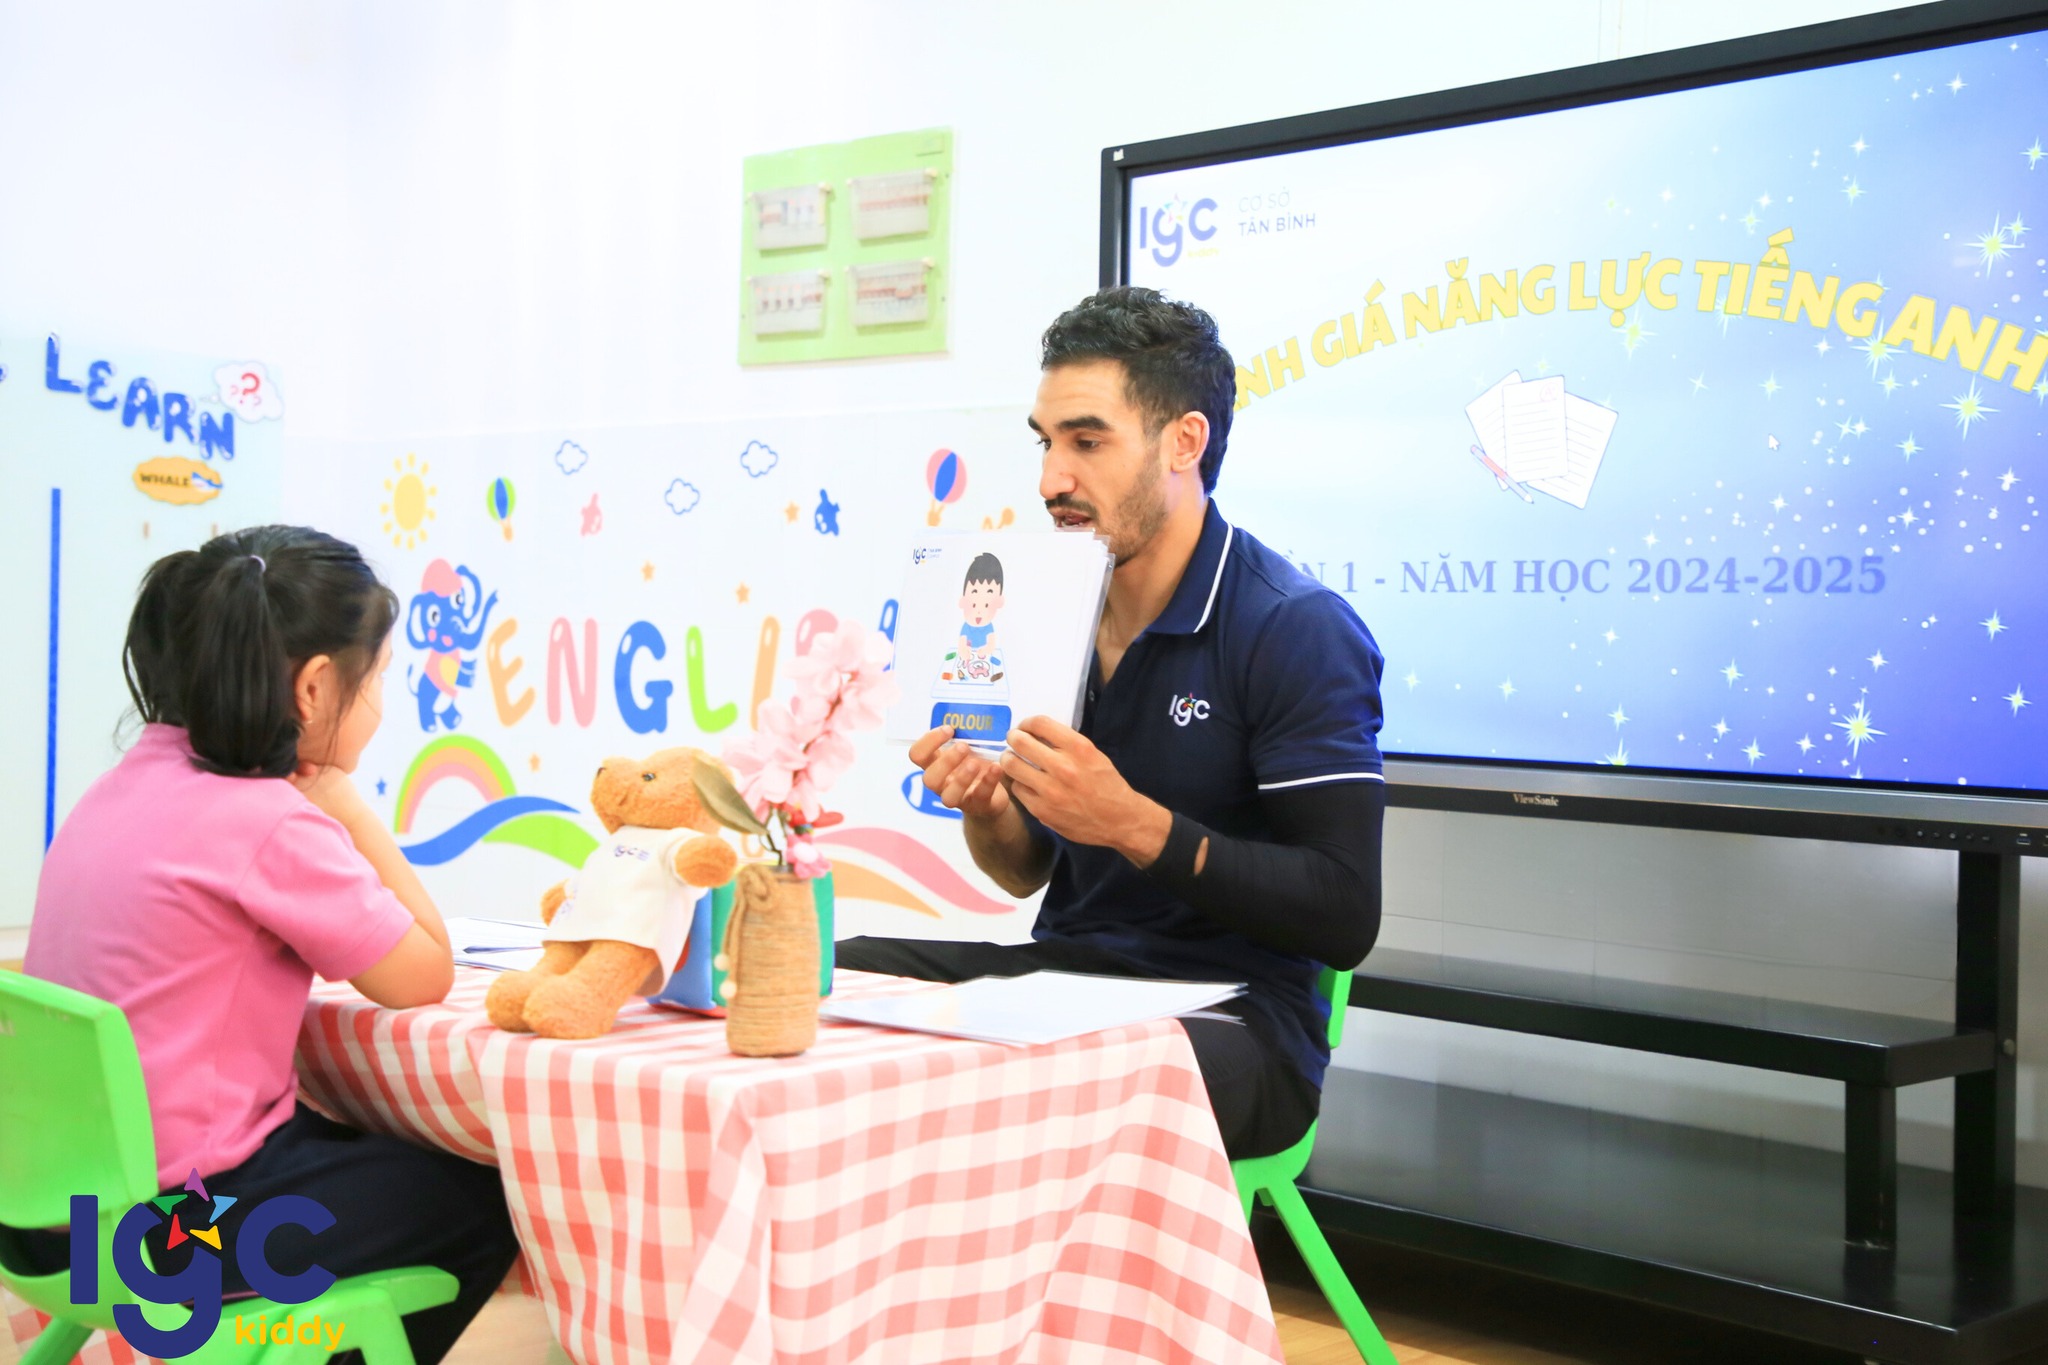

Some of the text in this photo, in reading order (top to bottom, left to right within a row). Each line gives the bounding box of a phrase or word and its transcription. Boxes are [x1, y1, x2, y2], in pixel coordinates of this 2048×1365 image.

[1311, 278, 1397, 368] GIÁ
[1402, 257, 1556, 340] NĂNG
[1568, 251, 1683, 328] LỰC
[1694, 226, 1885, 338] TIẾNG
[1881, 294, 2048, 393] ANH
[46, 332, 235, 460] LEARN
[140, 473, 190, 487] WHALE
[1342, 561, 1359, 593] 1
[1400, 552, 1497, 593] NĂM
[1512, 559, 1610, 602] HỌC
[1627, 556, 1887, 594] 2024-2025
[1513, 793, 1559, 806] ViewSonic
